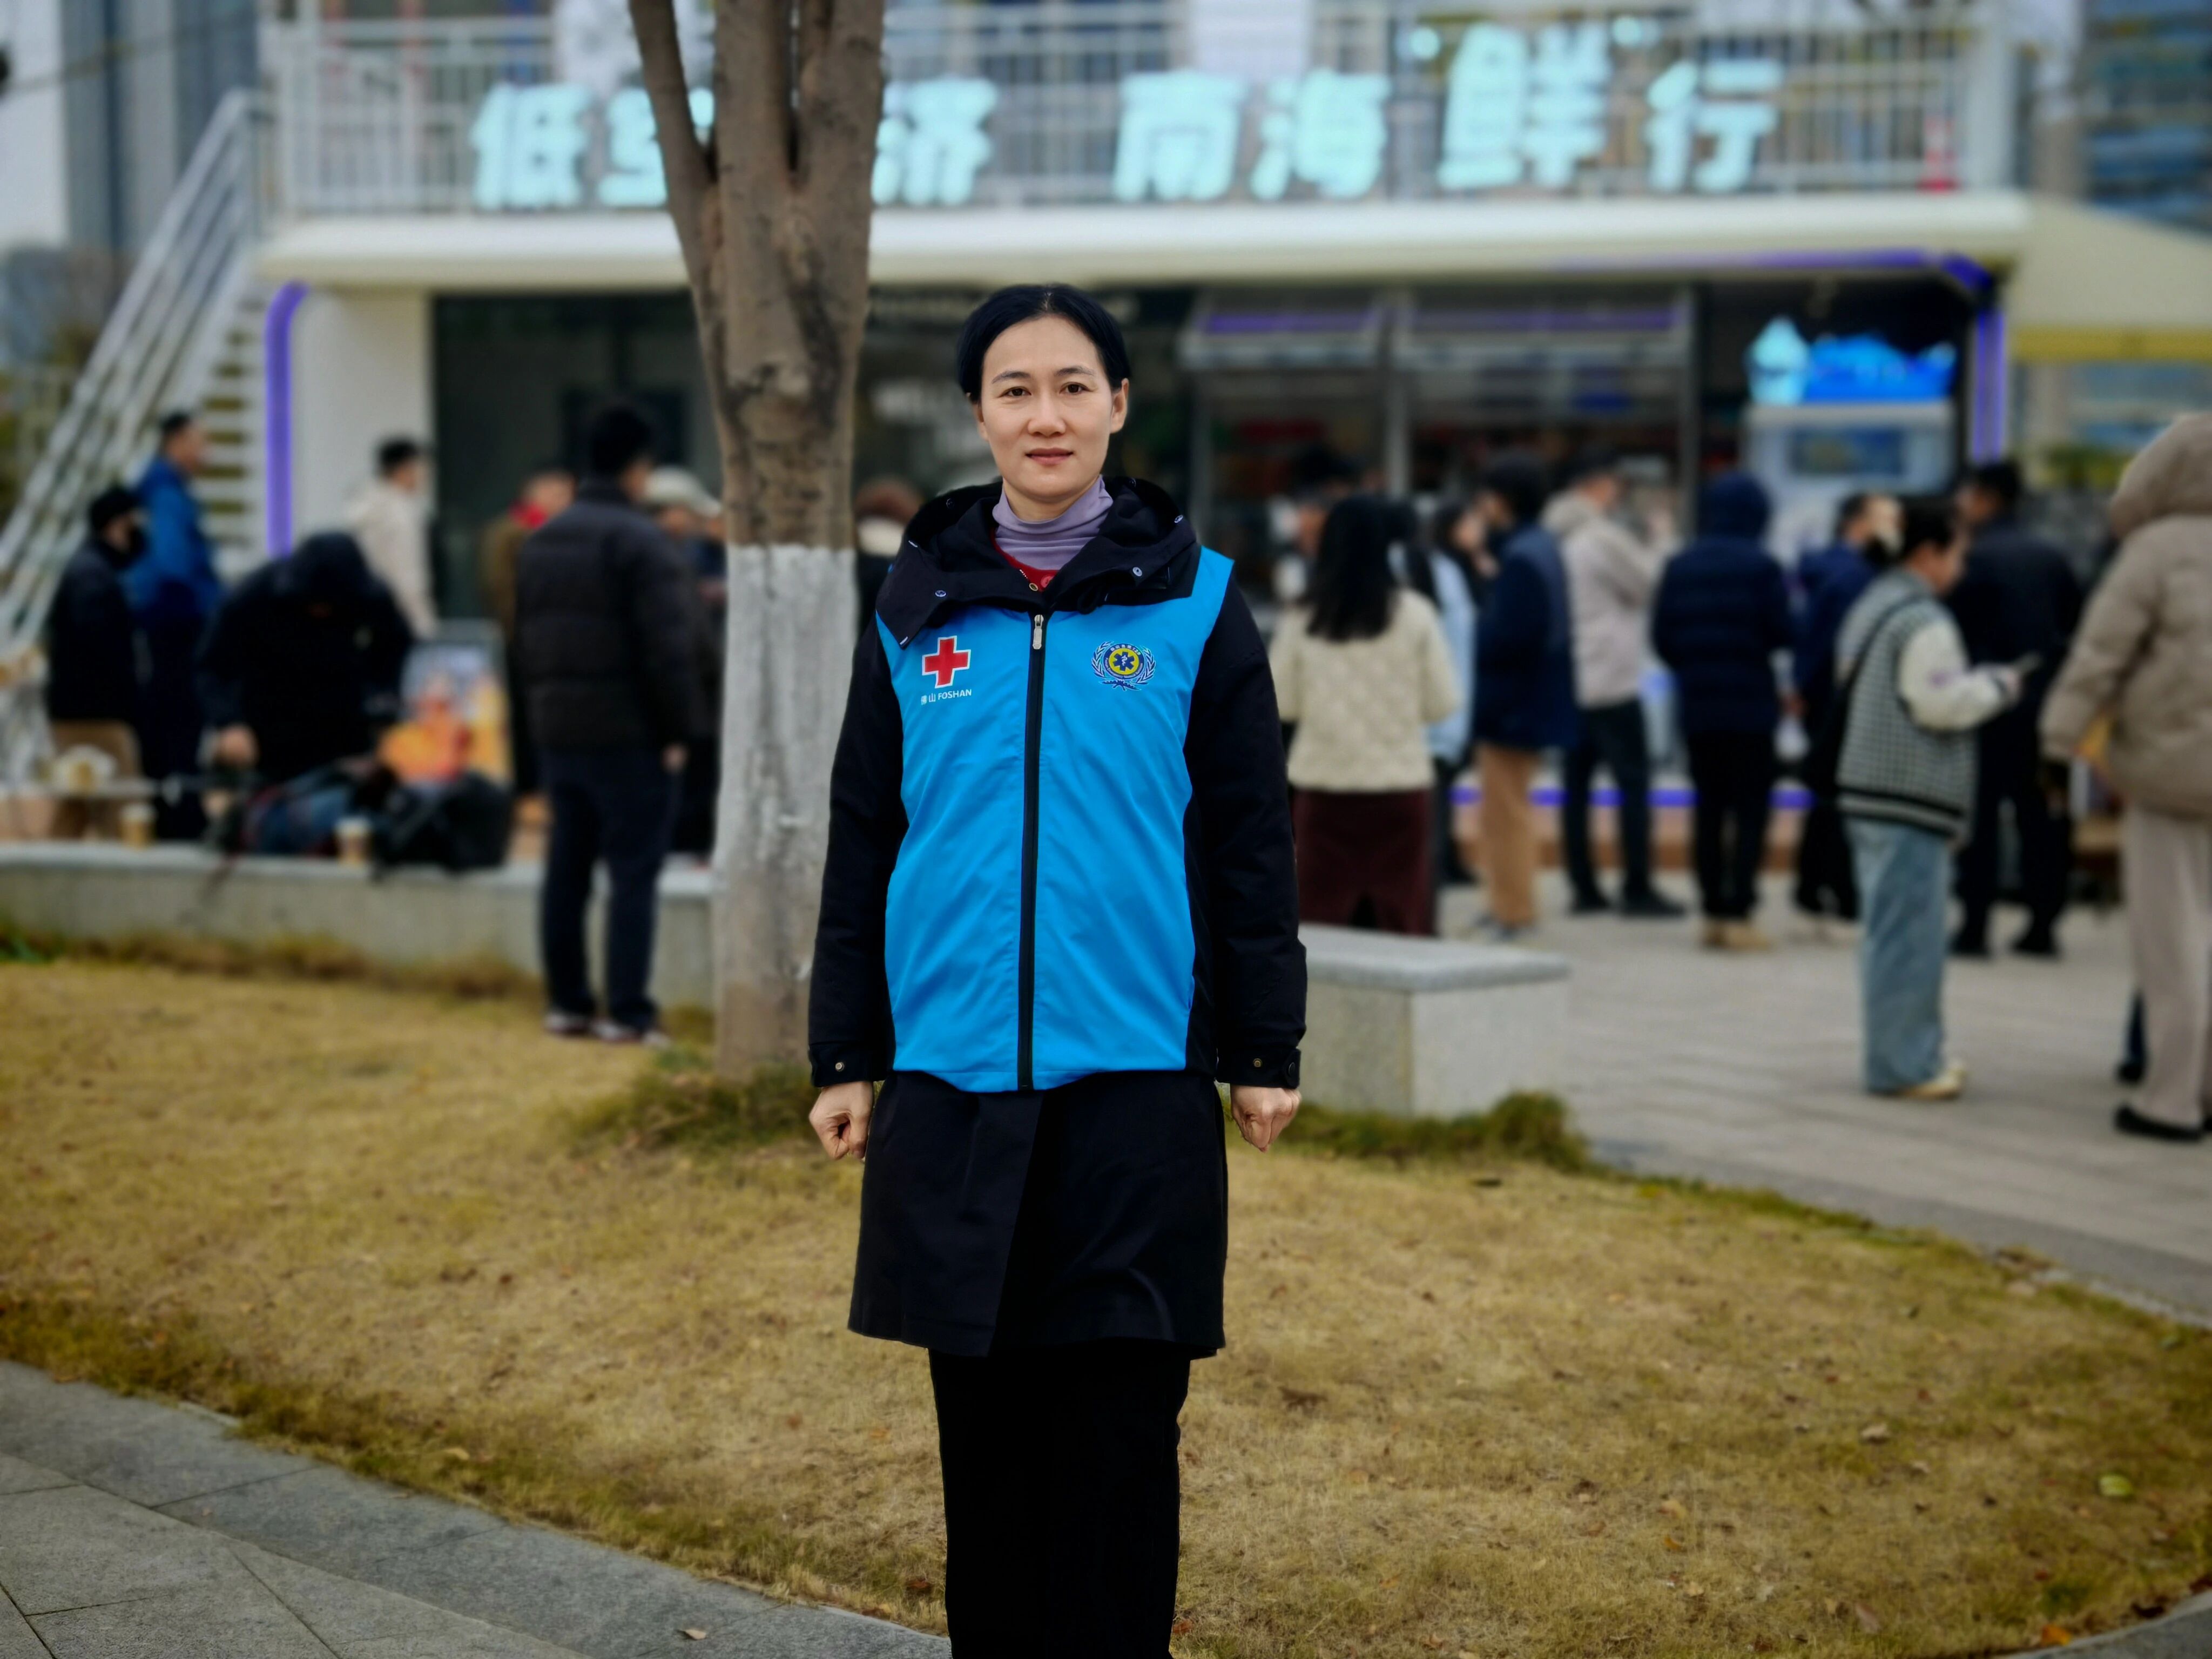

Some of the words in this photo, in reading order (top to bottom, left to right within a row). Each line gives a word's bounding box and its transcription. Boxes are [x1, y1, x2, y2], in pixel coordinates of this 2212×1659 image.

[471, 78, 997, 208] 低空济
[938, 689, 972, 700] FOSHAN
